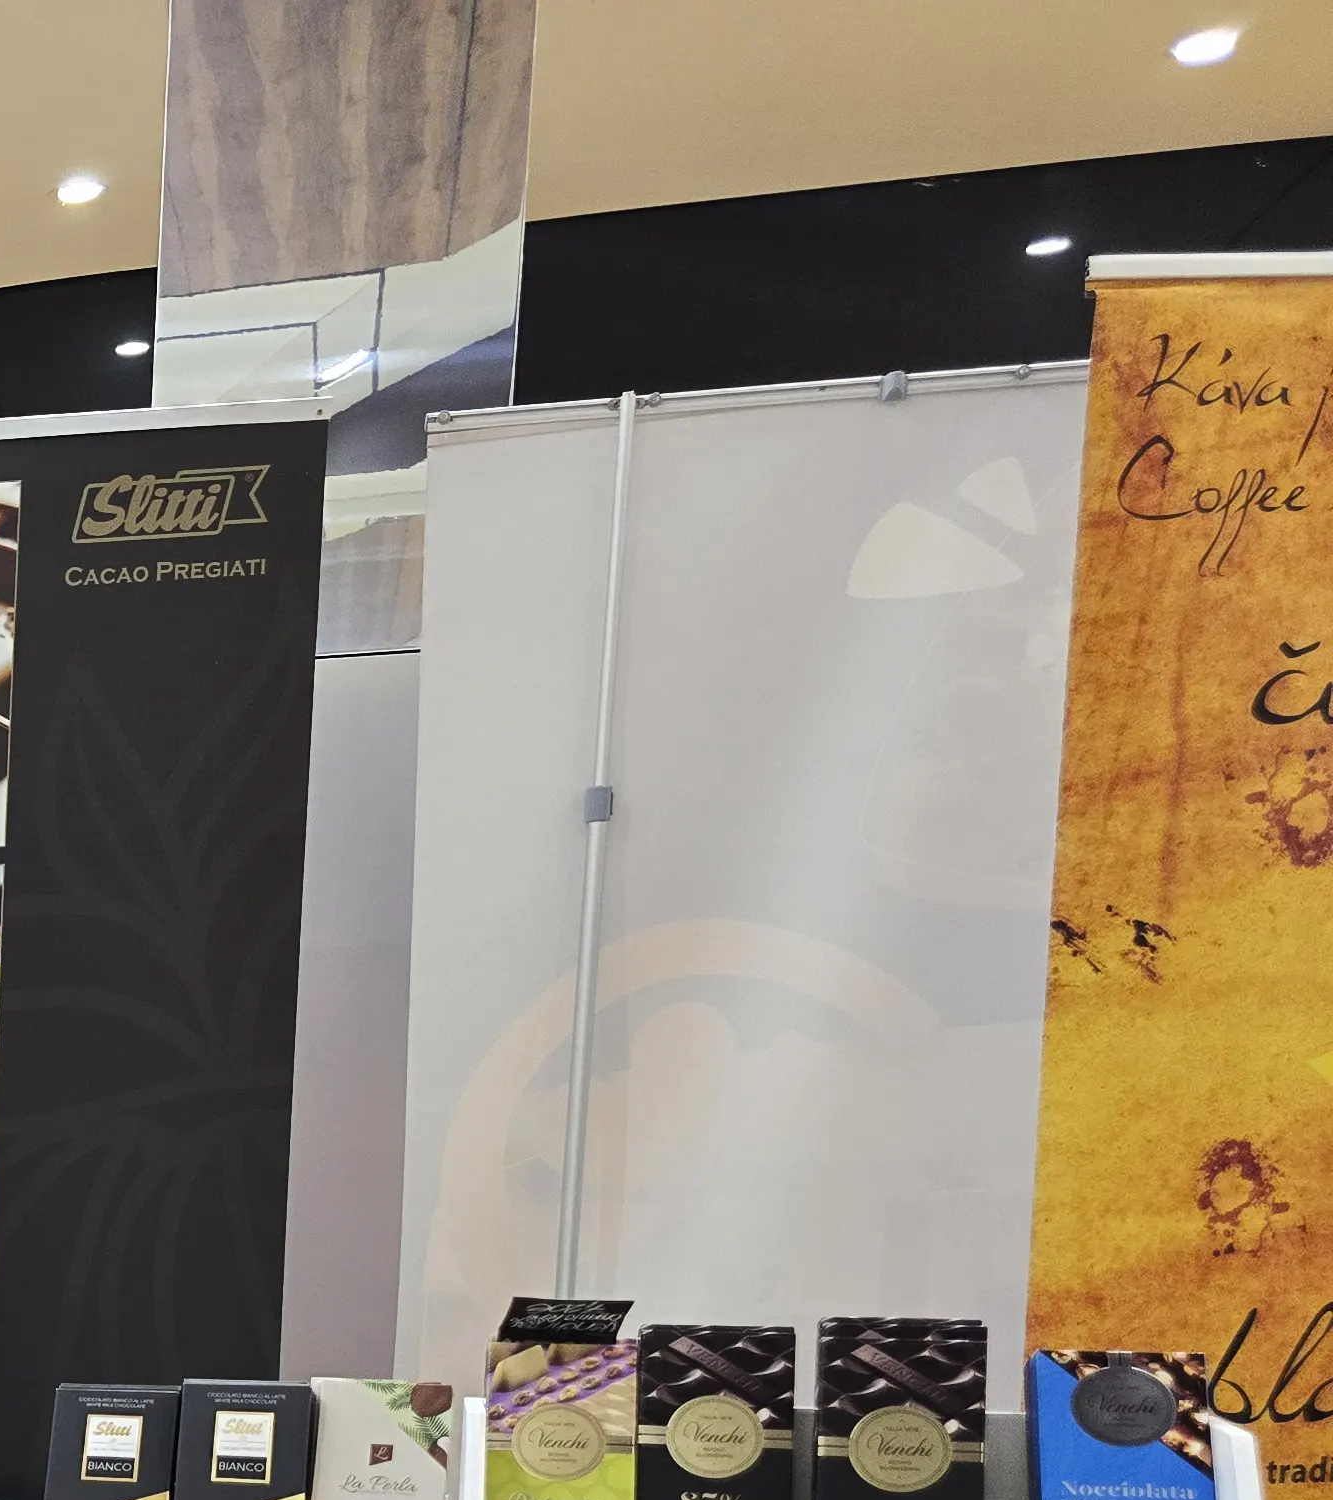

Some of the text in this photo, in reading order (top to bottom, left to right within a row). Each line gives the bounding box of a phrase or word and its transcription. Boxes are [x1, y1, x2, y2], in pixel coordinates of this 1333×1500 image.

[1137, 334, 1292, 413] Káva
[82, 474, 222, 536] Slitti
[1116, 434, 1311, 577] Coffee
[679, 1421, 747, 1445] Venchi
[866, 1431, 935, 1458] Venchi
[87, 1461, 132, 1472] BIANCO
[218, 1461, 265, 1472] BIANCO
[370, 1476, 418, 1493] Perla
